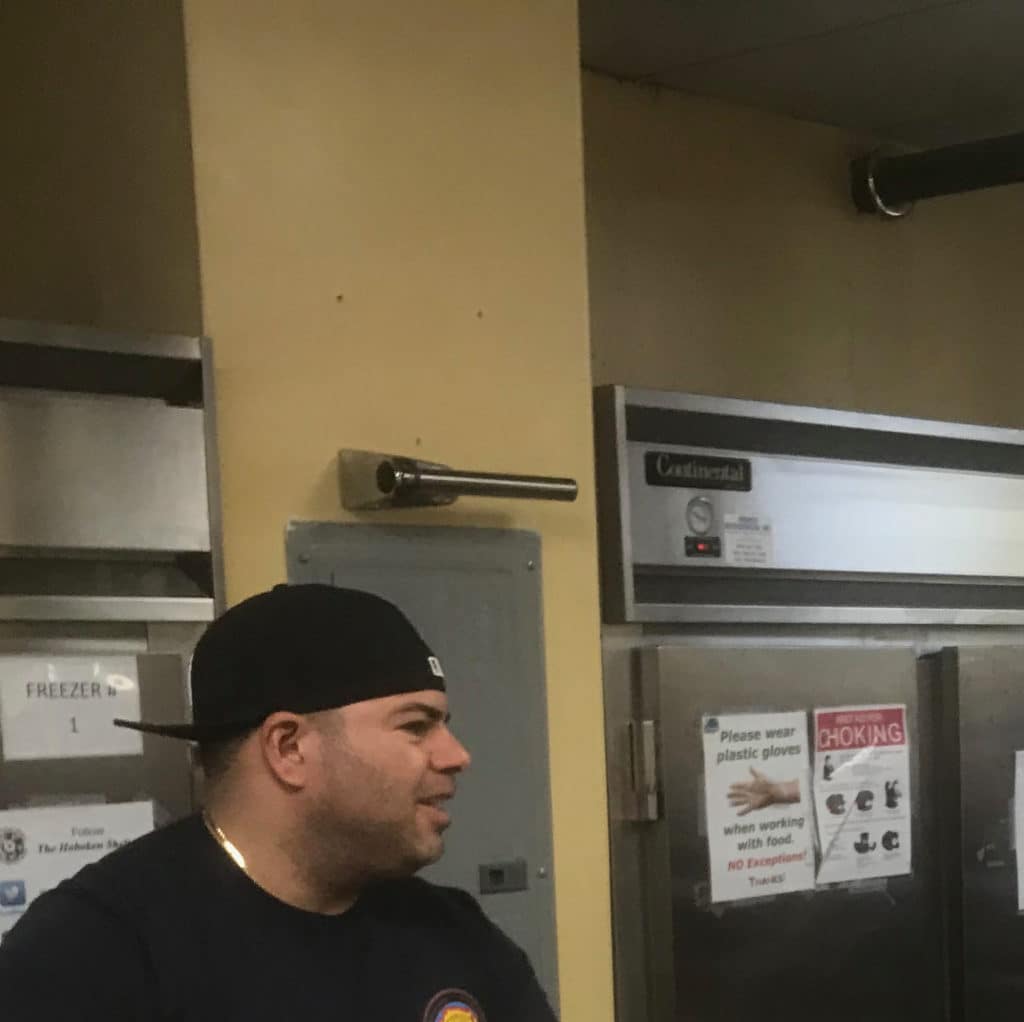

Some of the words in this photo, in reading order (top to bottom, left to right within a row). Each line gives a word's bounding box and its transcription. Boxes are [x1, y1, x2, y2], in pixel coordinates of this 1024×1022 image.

[26, 681, 102, 699] FREEZER
[70, 715, 80, 733] 1
[719, 729, 761, 744] Please
[765, 727, 796, 740] wear
[818, 722, 903, 749] CHOKING
[716, 746, 758, 765] plastic
[762, 743, 802, 761] gloves
[723, 823, 756, 836] when
[758, 816, 805, 831] working
[38, 840, 57, 853] The
[59, 838, 104, 853] Hoboken
[737, 837, 764, 851] with
[727, 858, 745, 872] NO
[747, 849, 808, 870] Exceptions!
